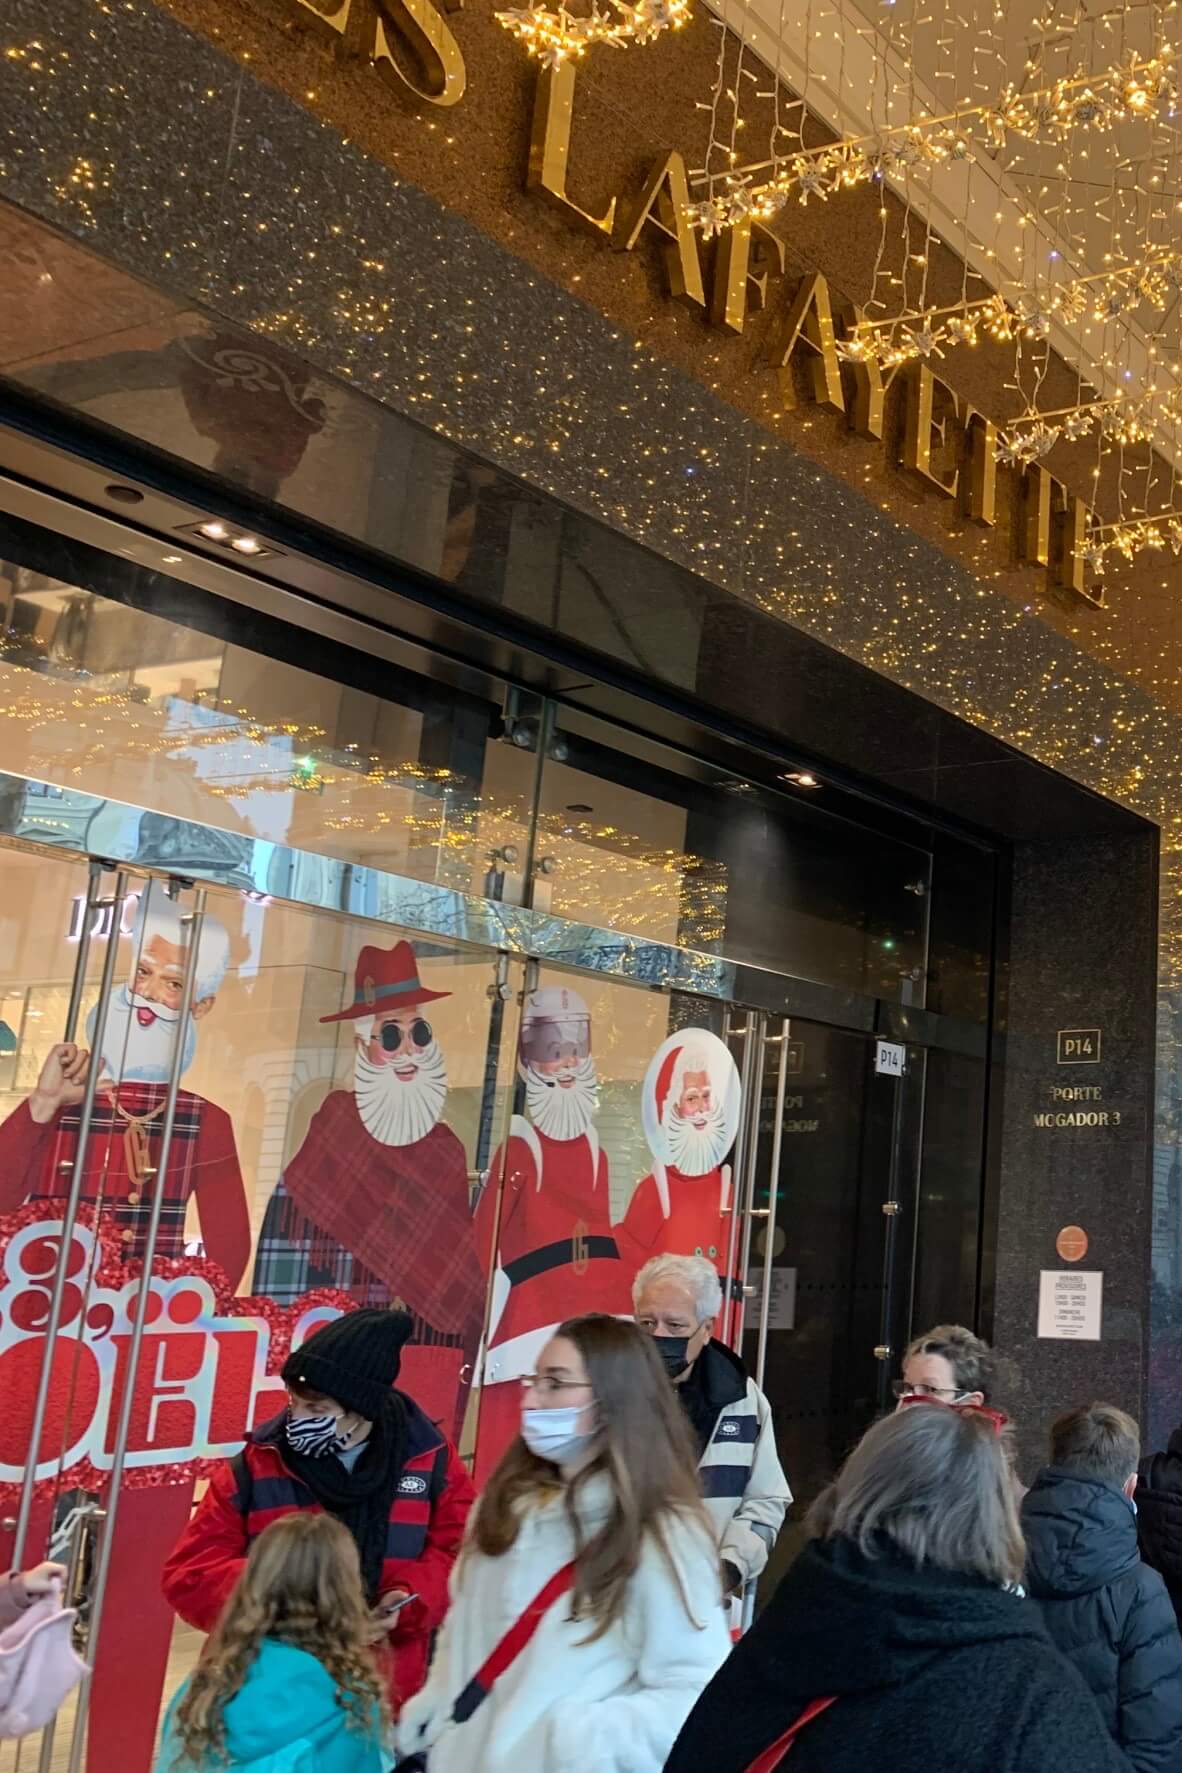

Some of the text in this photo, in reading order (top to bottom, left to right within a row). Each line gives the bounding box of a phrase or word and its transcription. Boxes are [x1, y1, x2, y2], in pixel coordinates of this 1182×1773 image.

[1064, 1037, 1094, 1056] P14
[880, 1049, 899, 1067] P14
[1052, 1086, 1102, 1101] PORTE
[1111, 1111, 1121, 1125] 3
